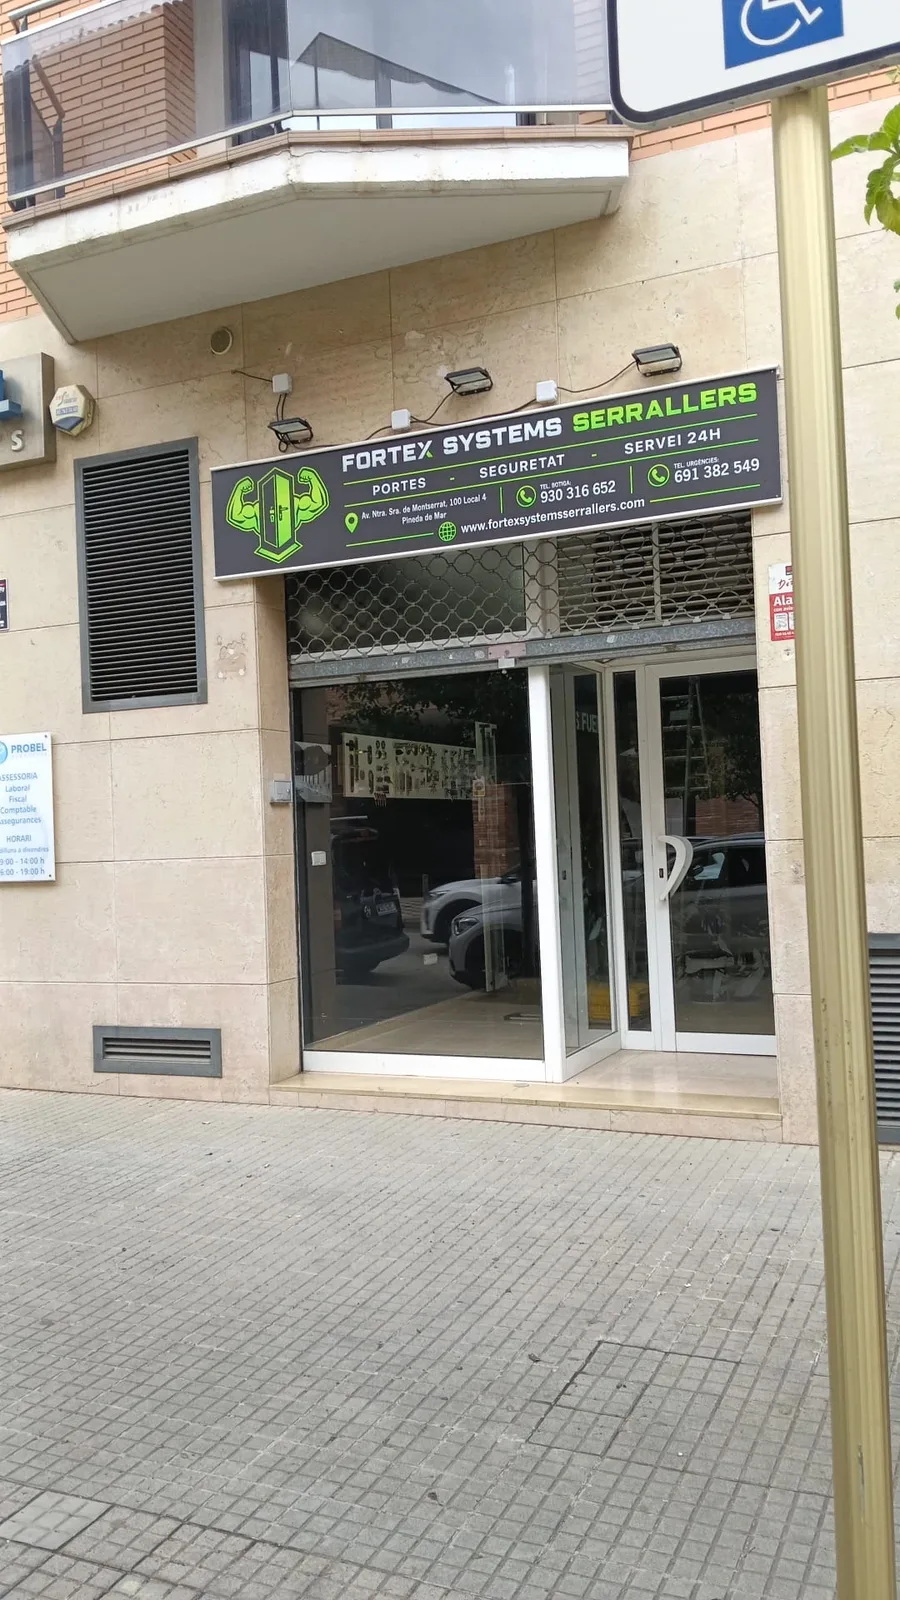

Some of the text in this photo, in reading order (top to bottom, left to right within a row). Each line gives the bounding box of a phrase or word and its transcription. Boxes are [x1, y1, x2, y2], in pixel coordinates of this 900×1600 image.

[342, 382, 757, 472] FORTEX SYSTEMS SERRALLERS
[372, 477, 426, 496] PORTES
[479, 454, 565, 478] SEGURETAT
[624, 434, 682, 454] SERVEI
[687, 428, 721, 444] 24H
[674, 458, 760, 483] 691 382 549
[540, 480, 616, 504] 930 316 652
[362, 512, 370, 520] Av.
[372, 510, 387, 518] Ntra.
[388, 508, 402, 516] Sra.
[402, 504, 410, 514] de
[449, 498, 462, 506] 100
[464, 494, 481, 504] Local
[482, 492, 487, 501] 4
[402, 512, 447, 525] Pineda de Mar
[460, 498, 645, 533] www.fortexsystemsserrallers.com
[773, 595, 793, 606] Ala
[582, 712, 598, 733] FUE
[11, 742, 47, 754] PROBEL
[5, 784, 30, 792] Laboral
[9, 795, 27, 803] Fiscal
[0, 804, 36, 814] Comptable
[0, 817, 41, 826] ssegurances
[6, 834, 32, 842] HORARI
[40, 856, 45, 864] h
